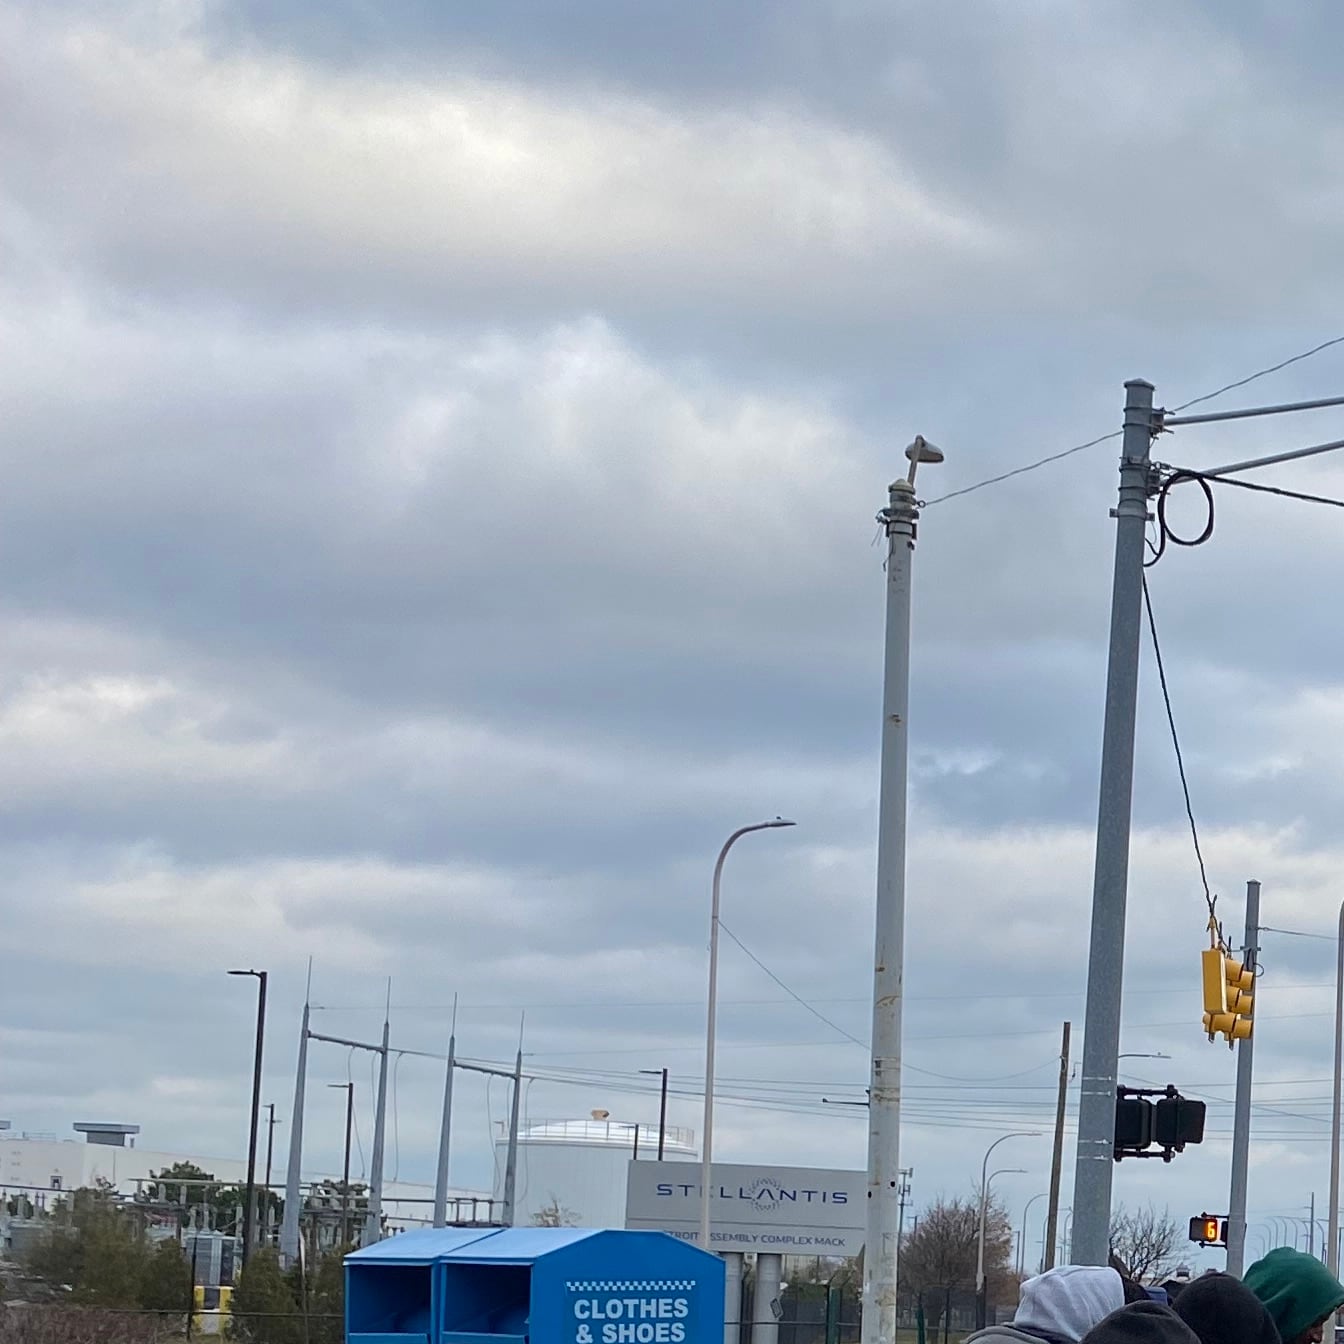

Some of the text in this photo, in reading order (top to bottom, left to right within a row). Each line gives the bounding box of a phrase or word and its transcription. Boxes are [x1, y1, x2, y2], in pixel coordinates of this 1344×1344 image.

[656, 1183, 849, 1204] STLLANTIS
[709, 1232, 758, 1243] SSEMBLY
[760, 1234, 813, 1246] COMPLEX
[814, 1237, 846, 1247] MACK
[574, 1298, 689, 1319] CLOTHES
[575, 1322, 686, 1344] & SHOES
